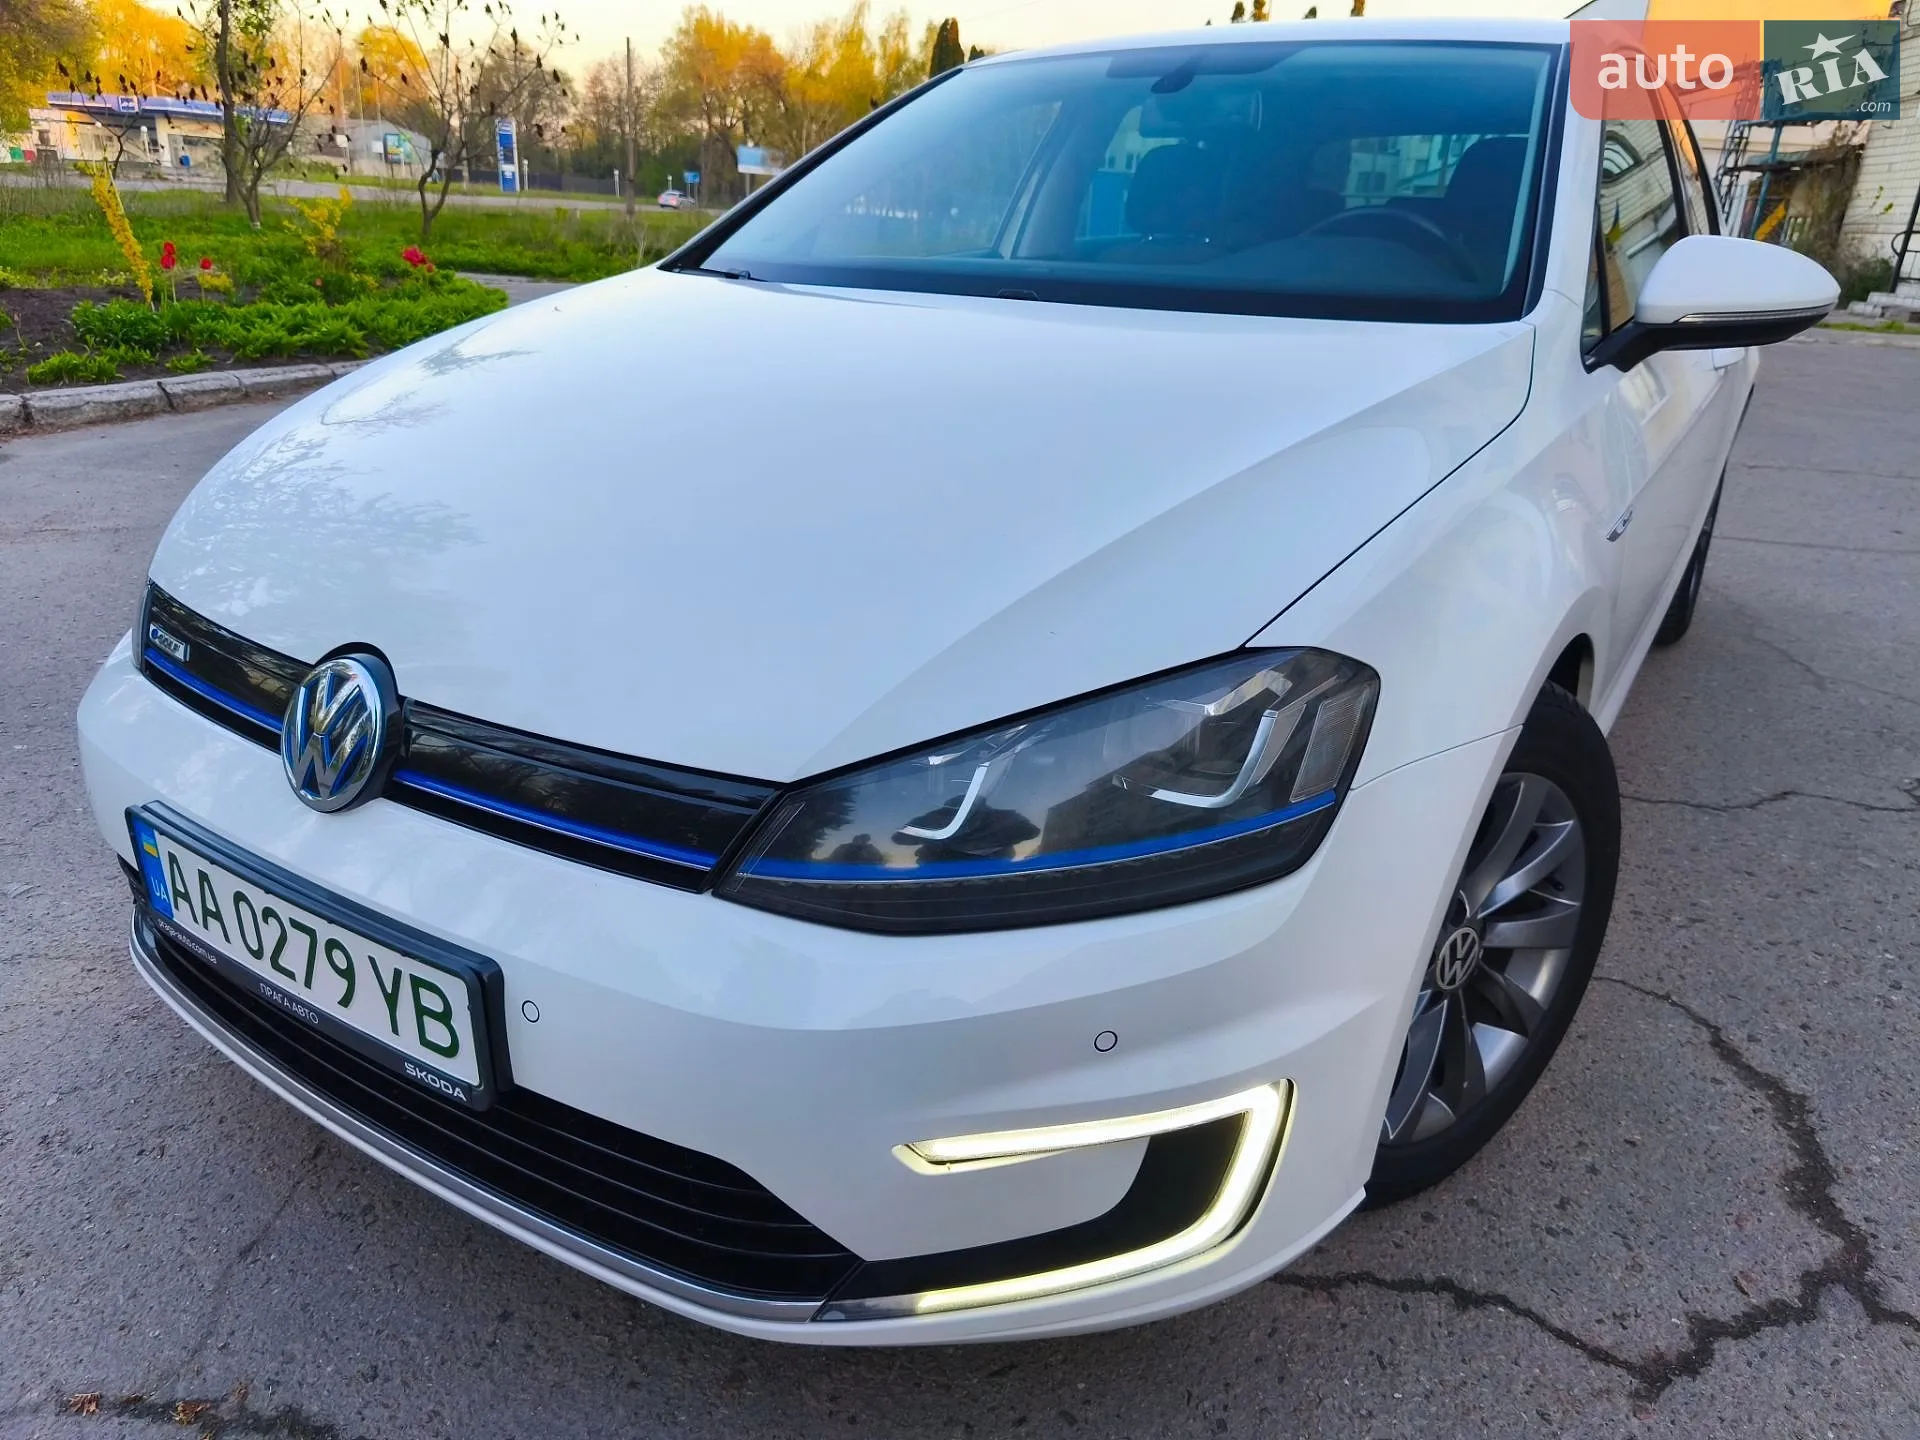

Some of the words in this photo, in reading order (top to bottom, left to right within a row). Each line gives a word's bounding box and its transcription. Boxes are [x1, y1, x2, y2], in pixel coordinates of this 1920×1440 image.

[151, 876, 169, 903] UA
[292, 1002, 319, 1024] АВТО
[404, 1061, 467, 1102] SKODA
